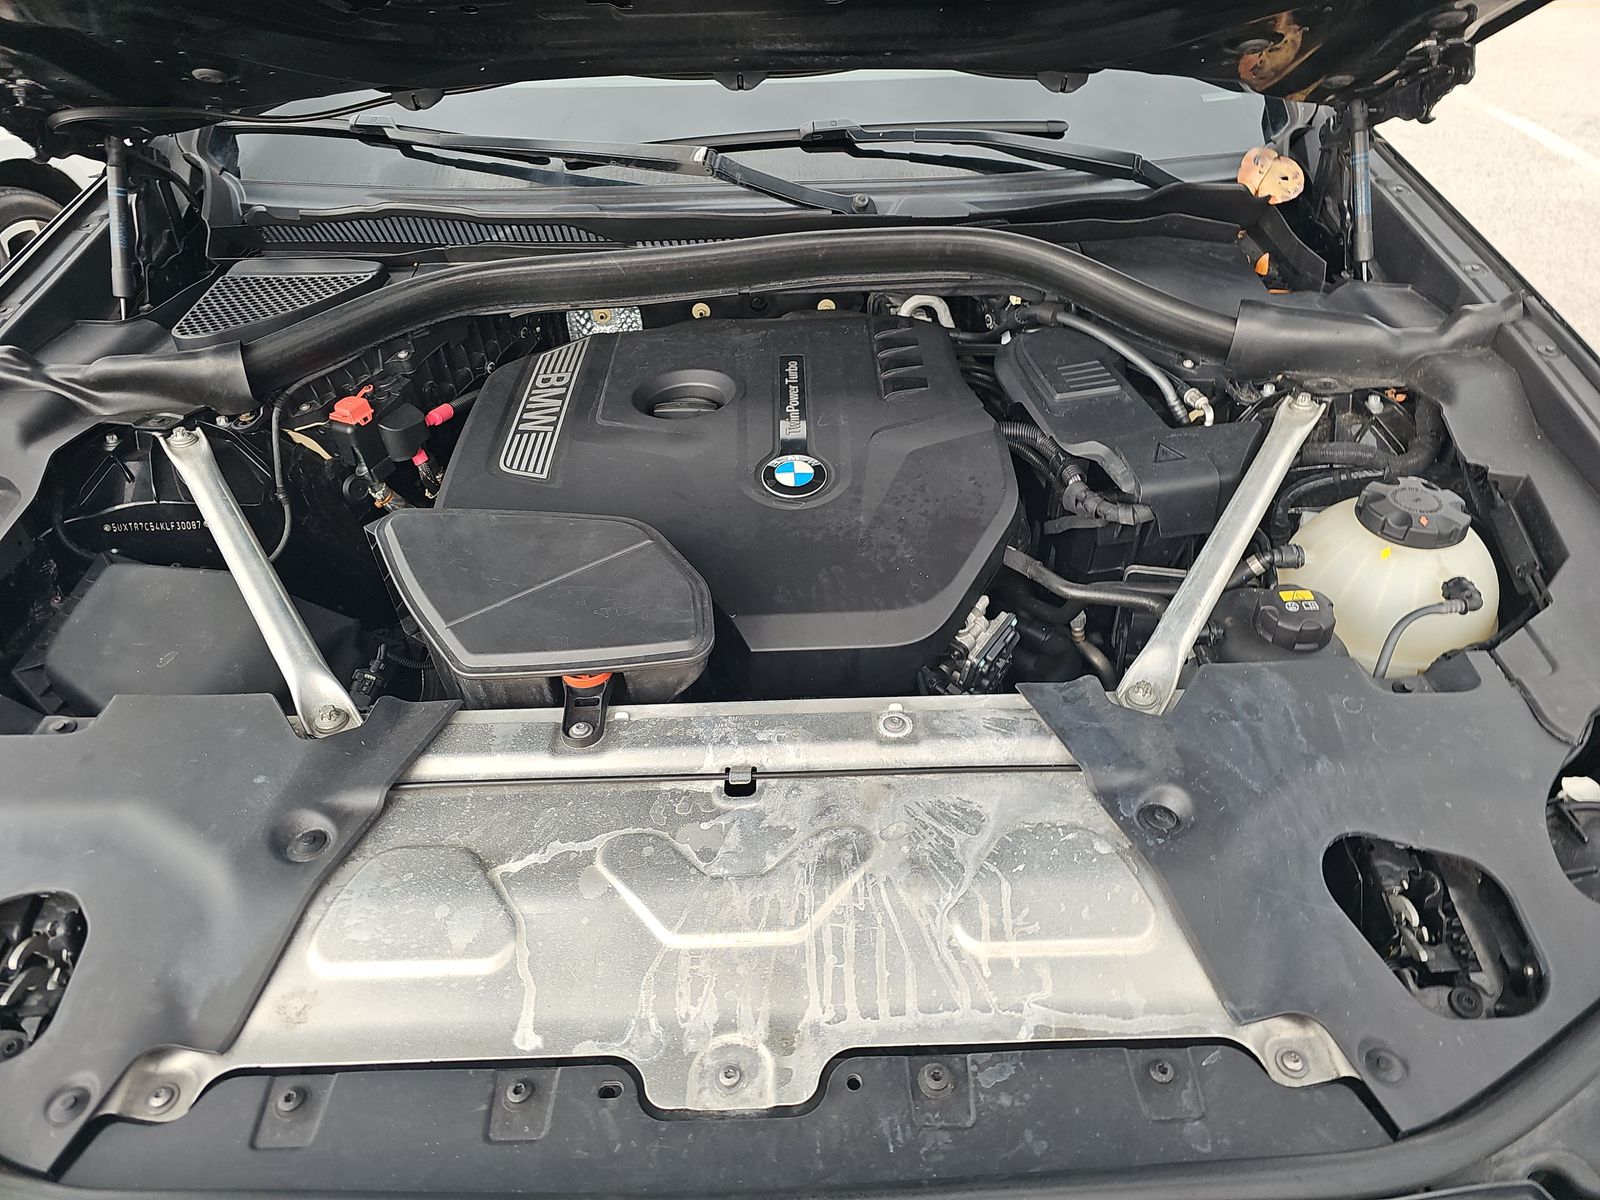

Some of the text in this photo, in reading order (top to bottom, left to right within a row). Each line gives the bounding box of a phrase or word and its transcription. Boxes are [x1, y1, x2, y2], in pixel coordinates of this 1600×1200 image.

[518, 372, 572, 431] BMW
[785, 360, 801, 435] TwinPower Turbo
